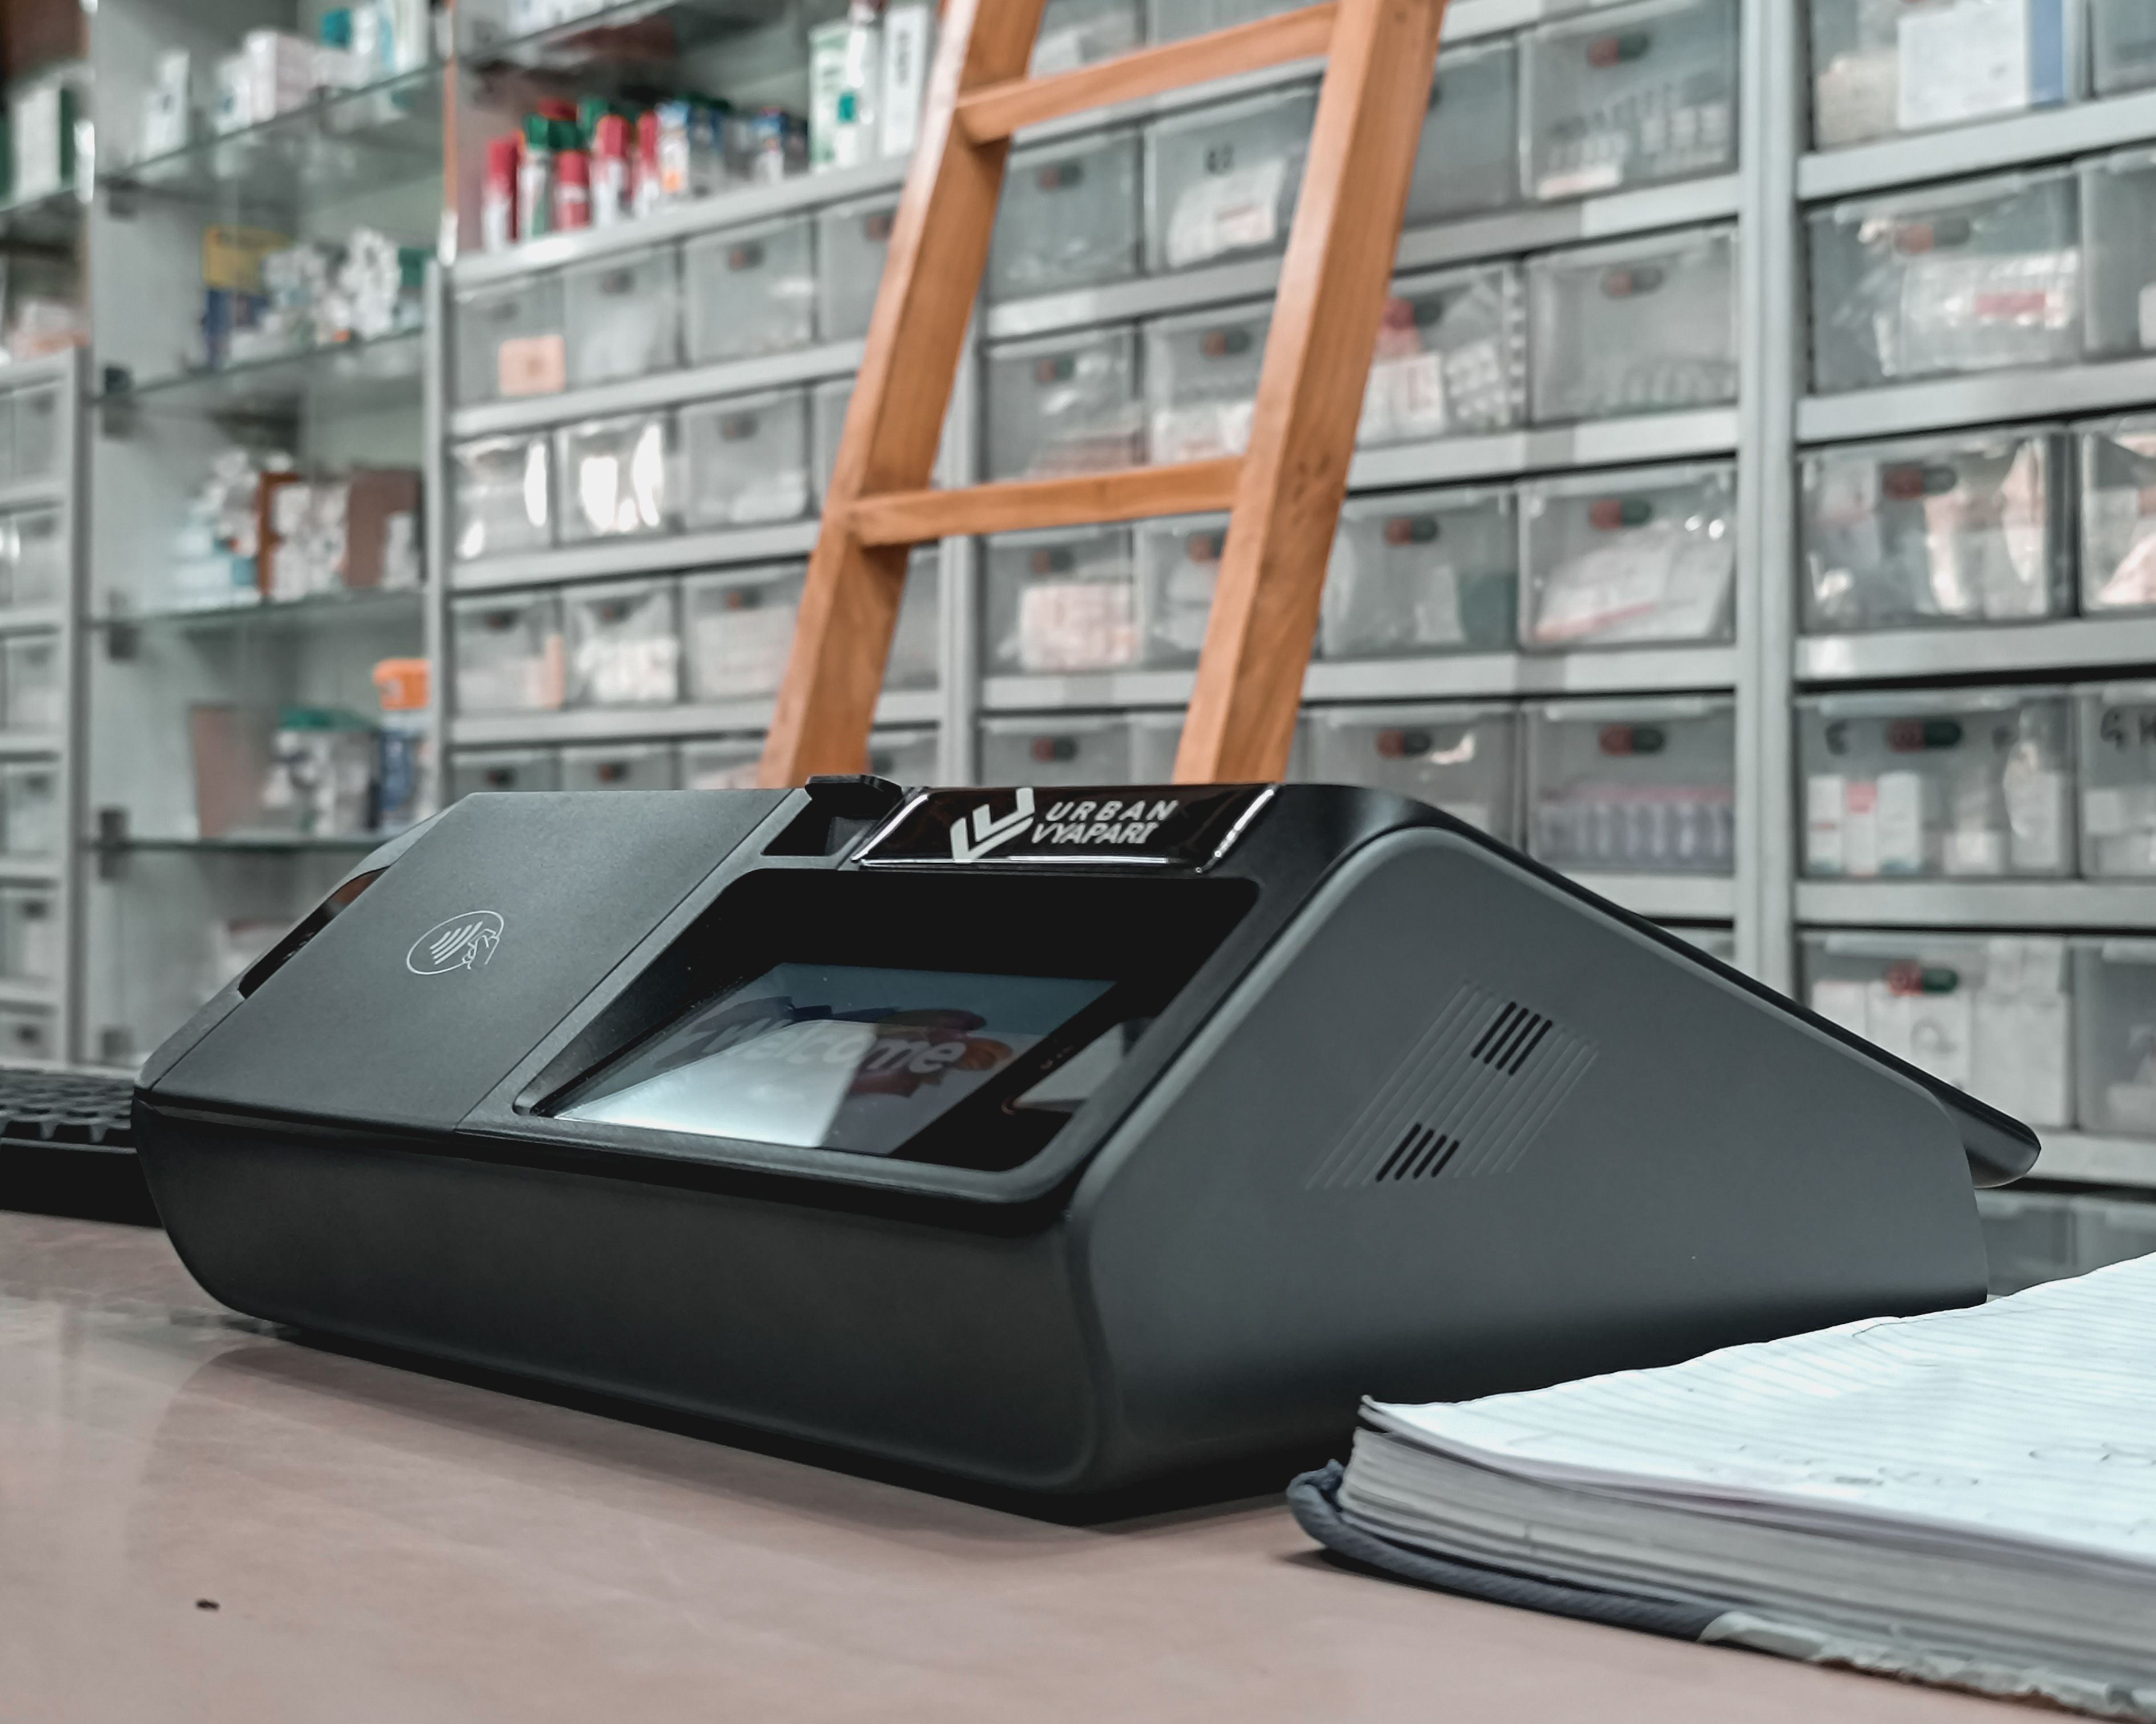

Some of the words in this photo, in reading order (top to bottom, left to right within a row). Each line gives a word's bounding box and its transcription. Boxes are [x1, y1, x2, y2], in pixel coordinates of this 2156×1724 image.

[1045, 800, 1179, 822] URBAN
[1032, 822, 1159, 844] VYAPARI
[701, 1018, 967, 1074] Welcome
